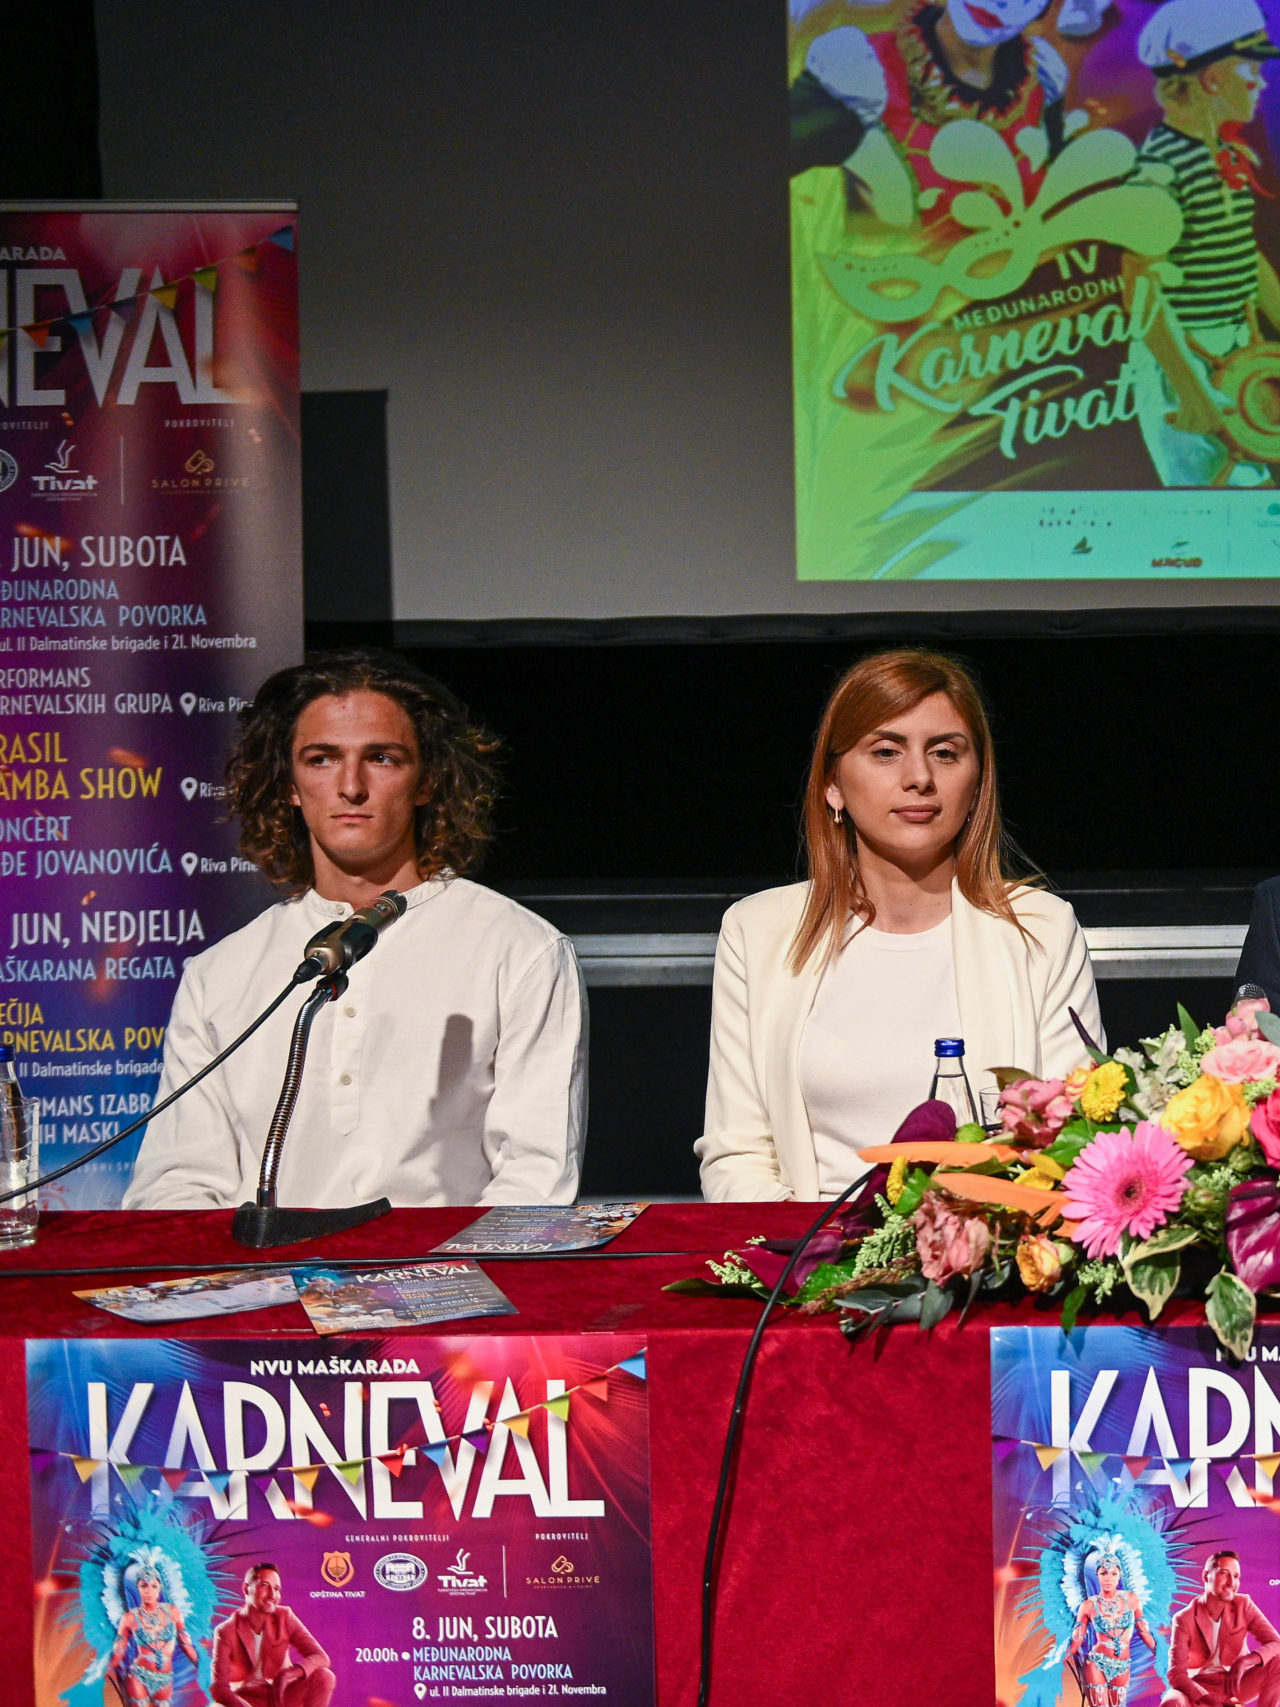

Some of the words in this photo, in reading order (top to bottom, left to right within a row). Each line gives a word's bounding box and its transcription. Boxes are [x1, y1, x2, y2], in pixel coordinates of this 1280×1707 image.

[0, 246, 67, 261] ARADA
[1056, 244, 1098, 280] IV
[0, 264, 256, 408] EVAL
[833, 275, 1161, 413] Karneval
[967, 363, 1147, 460] Tivat
[32, 475, 98, 490] Tivat
[11, 536, 70, 573] JUN,
[80, 535, 188, 568] SUBOTA
[0, 578, 119, 602] ĐUNARODNA
[0, 605, 107, 629] RNEVALSKA
[118, 604, 208, 627] POVORKA
[30, 635, 107, 652] Dalmatinske
[111, 635, 160, 653] brigade
[191, 633, 257, 650] Novembra
[0, 666, 91, 689] RFORMANS
[0, 693, 106, 716] RNEVALSKIH
[114, 692, 174, 715] GRUPA
[199, 697, 225, 713] Riva
[0, 731, 68, 764] RASIL
[80, 766, 163, 800] SHOW
[0, 851, 26, 877] ĐE
[35, 842, 174, 879] JOVANOVIĆA
[200, 857, 227, 873] Riva
[10, 910, 70, 950] JUN,
[82, 908, 205, 946] NEDJELJA
[105, 955, 176, 981] REGATA
[0, 997, 44, 1028] EČIJA
[0, 1029, 115, 1054] RNEVALSKA
[33, 1061, 112, 1077] Dalmatinske
[100, 1093, 151, 1115] IZABR
[356, 1264, 478, 1284] KARNEVAL
[250, 1359, 292, 1376] NVU
[297, 1355, 420, 1375] MAŠKARADA
[87, 1375, 605, 1522] KARNEVAL
[437, 1575, 488, 1588] Tivat
[526, 1576, 563, 1584] SALON
[309, 1590, 342, 1599] OPŠTINA
[343, 1590, 365, 1598] TIVAT
[412, 1616, 431, 1640] 8.
[437, 1616, 479, 1642] JUN,
[484, 1615, 558, 1639] SUBOTA
[355, 1648, 399, 1662] 20.00h
[413, 1645, 512, 1662] MEĐUNARODNA
[413, 1664, 504, 1681] KARNEVALSKA
[511, 1663, 573, 1679] POVORKA
[443, 1686, 449, 1696] II
[452, 1685, 504, 1697] Dalmatinske
[507, 1685, 540, 1698] brigade
[561, 1684, 607, 1696] Novembra
